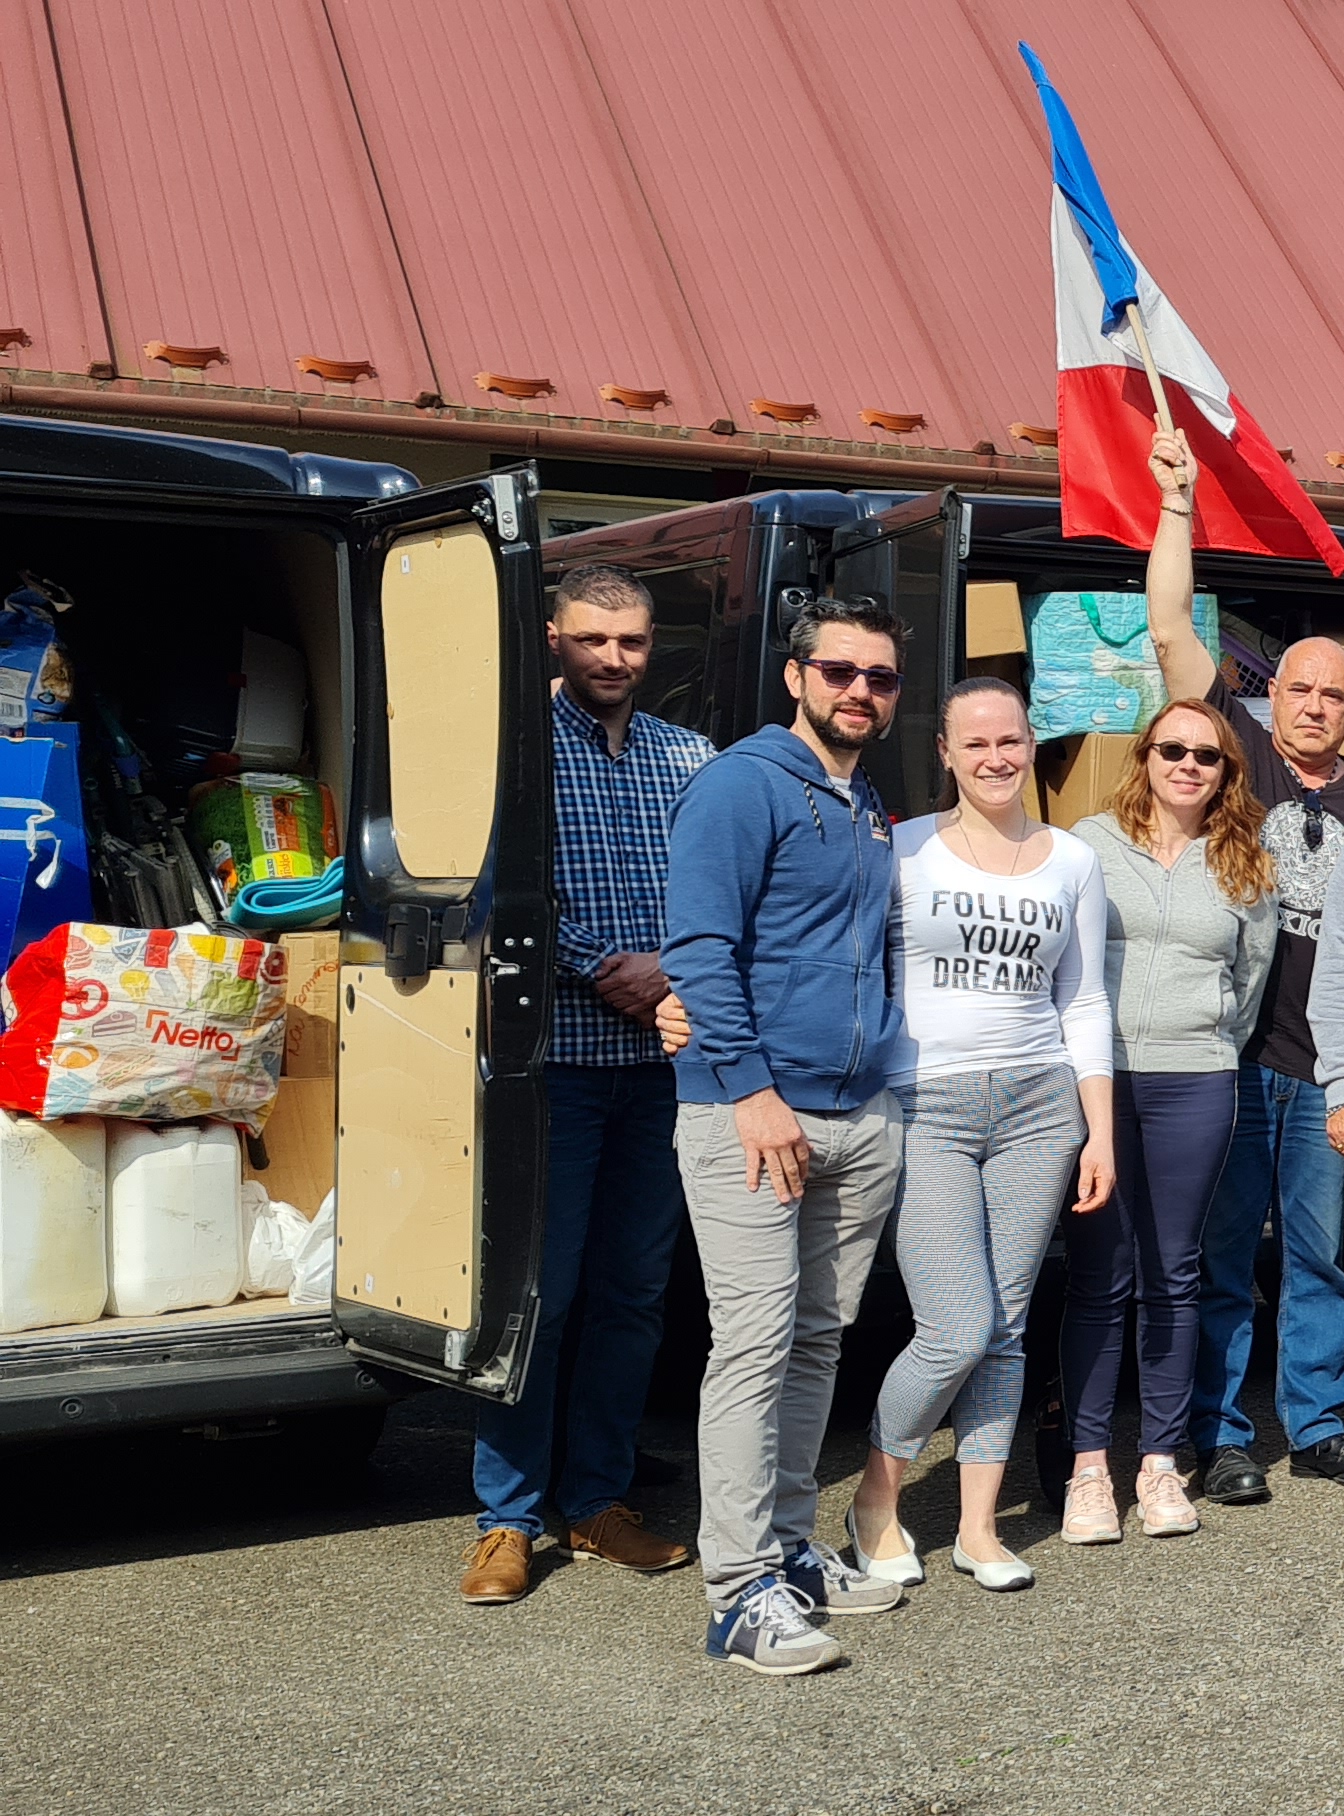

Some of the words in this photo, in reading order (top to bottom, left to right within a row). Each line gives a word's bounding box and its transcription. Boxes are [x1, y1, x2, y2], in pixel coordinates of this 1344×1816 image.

[931, 889, 1063, 933] FOLLOW
[958, 923, 1041, 960] YOUR
[932, 956, 1045, 992] DREAMS
[150, 1019, 235, 1052] Netto
